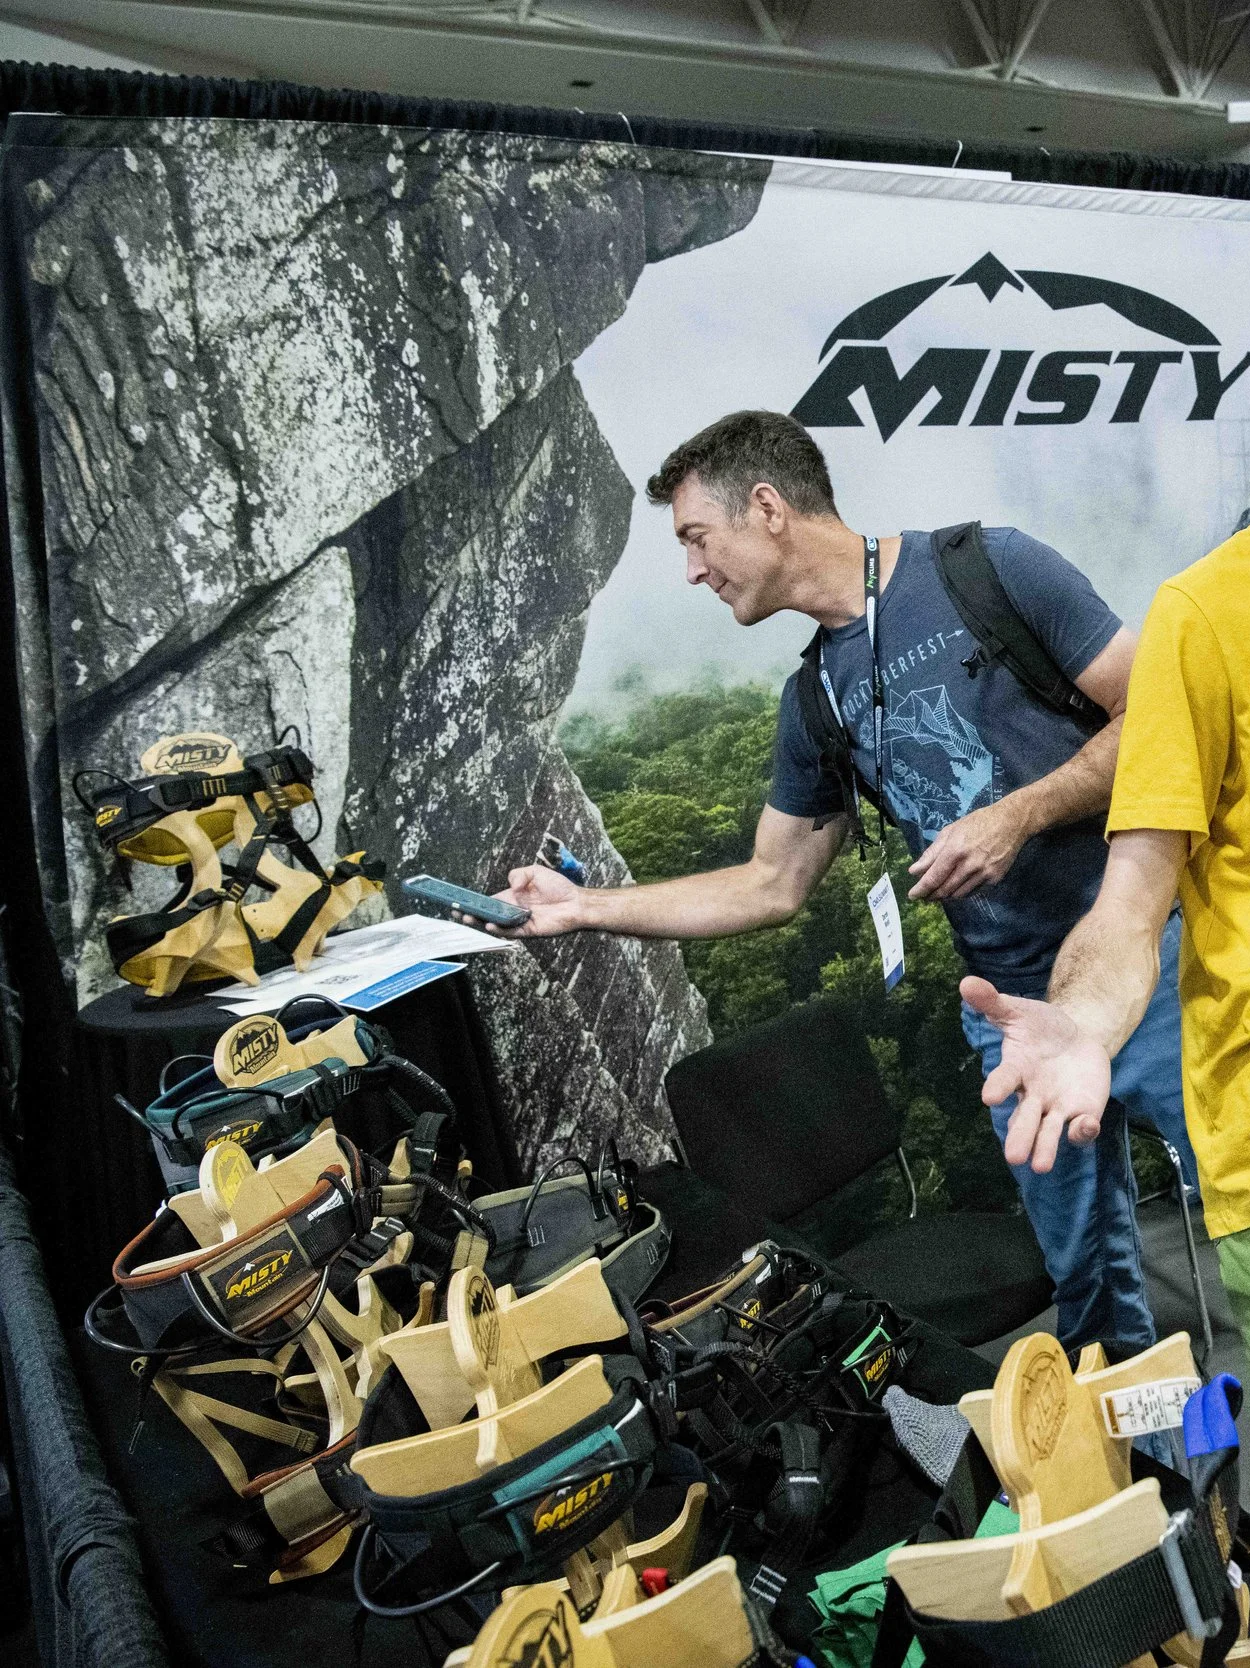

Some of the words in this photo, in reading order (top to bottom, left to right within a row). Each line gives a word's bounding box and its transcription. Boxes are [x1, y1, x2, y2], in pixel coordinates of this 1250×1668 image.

[843, 632, 947, 721] ROCKTBERFEST
[155, 745, 232, 769] MISTY
[233, 1023, 278, 1076] MISTY
[227, 1250, 293, 1299] MISTY
[247, 1272, 284, 1297] Mountain
[535, 1472, 613, 1535] MISTY
